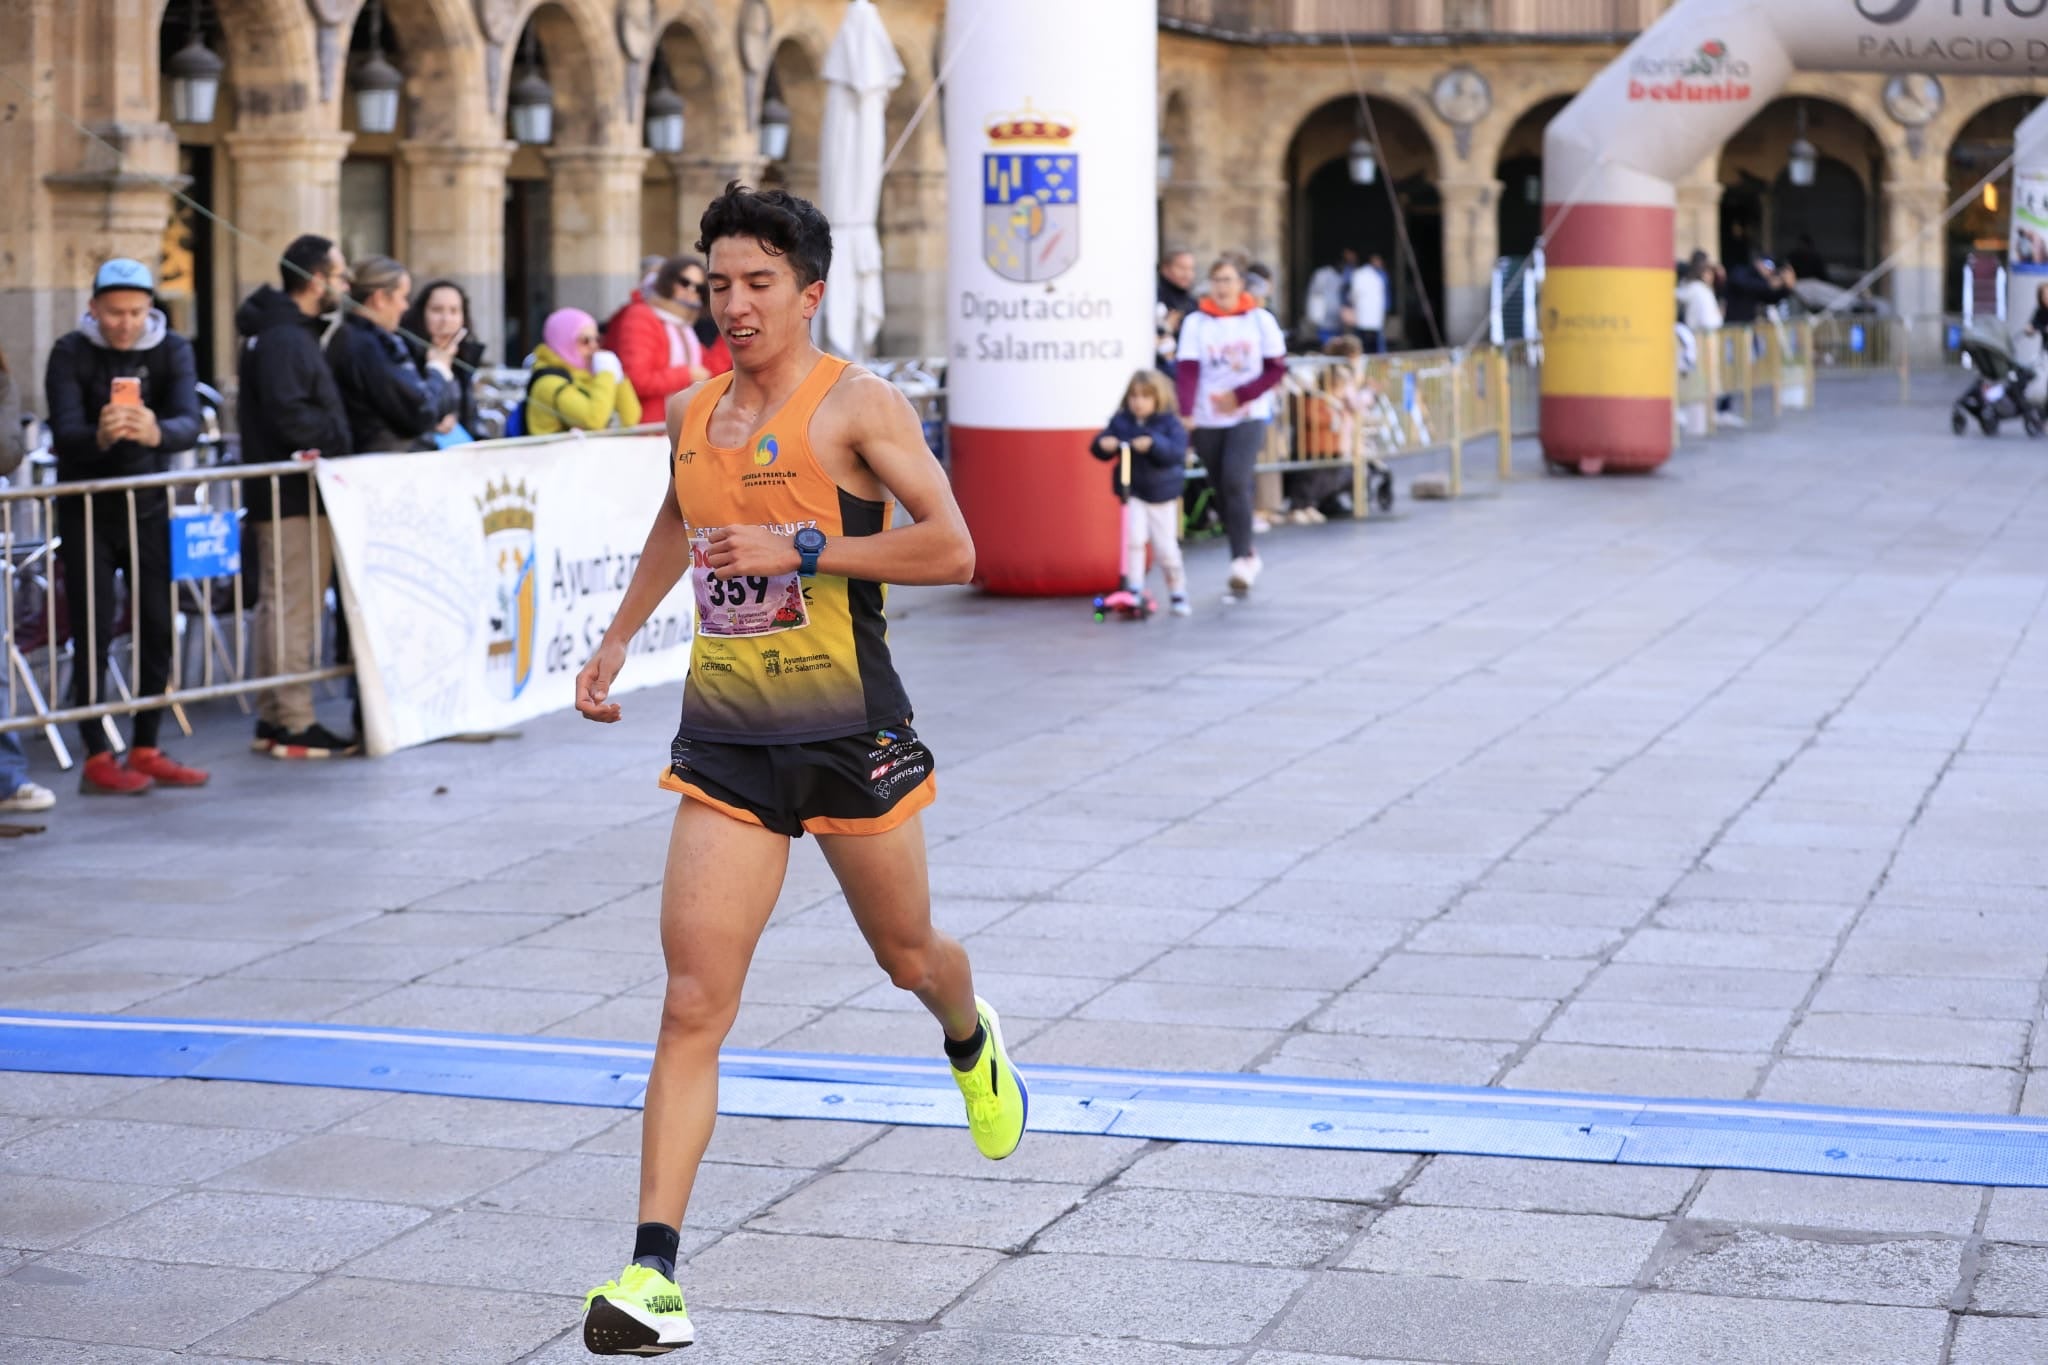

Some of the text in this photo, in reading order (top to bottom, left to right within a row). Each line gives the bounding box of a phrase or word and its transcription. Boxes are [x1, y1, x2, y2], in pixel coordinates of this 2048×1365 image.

[1857, 34, 2014, 62] PALACIO
[960, 289, 1113, 325] Diputación
[975, 332, 1124, 361] Salamanca
[707, 571, 768, 606] 359
[547, 621, 573, 673] de
[784, 653, 830, 665] Ayuntamiento
[785, 662, 831, 674] de Salamanca
[890, 764, 925, 785] CERVISAN
